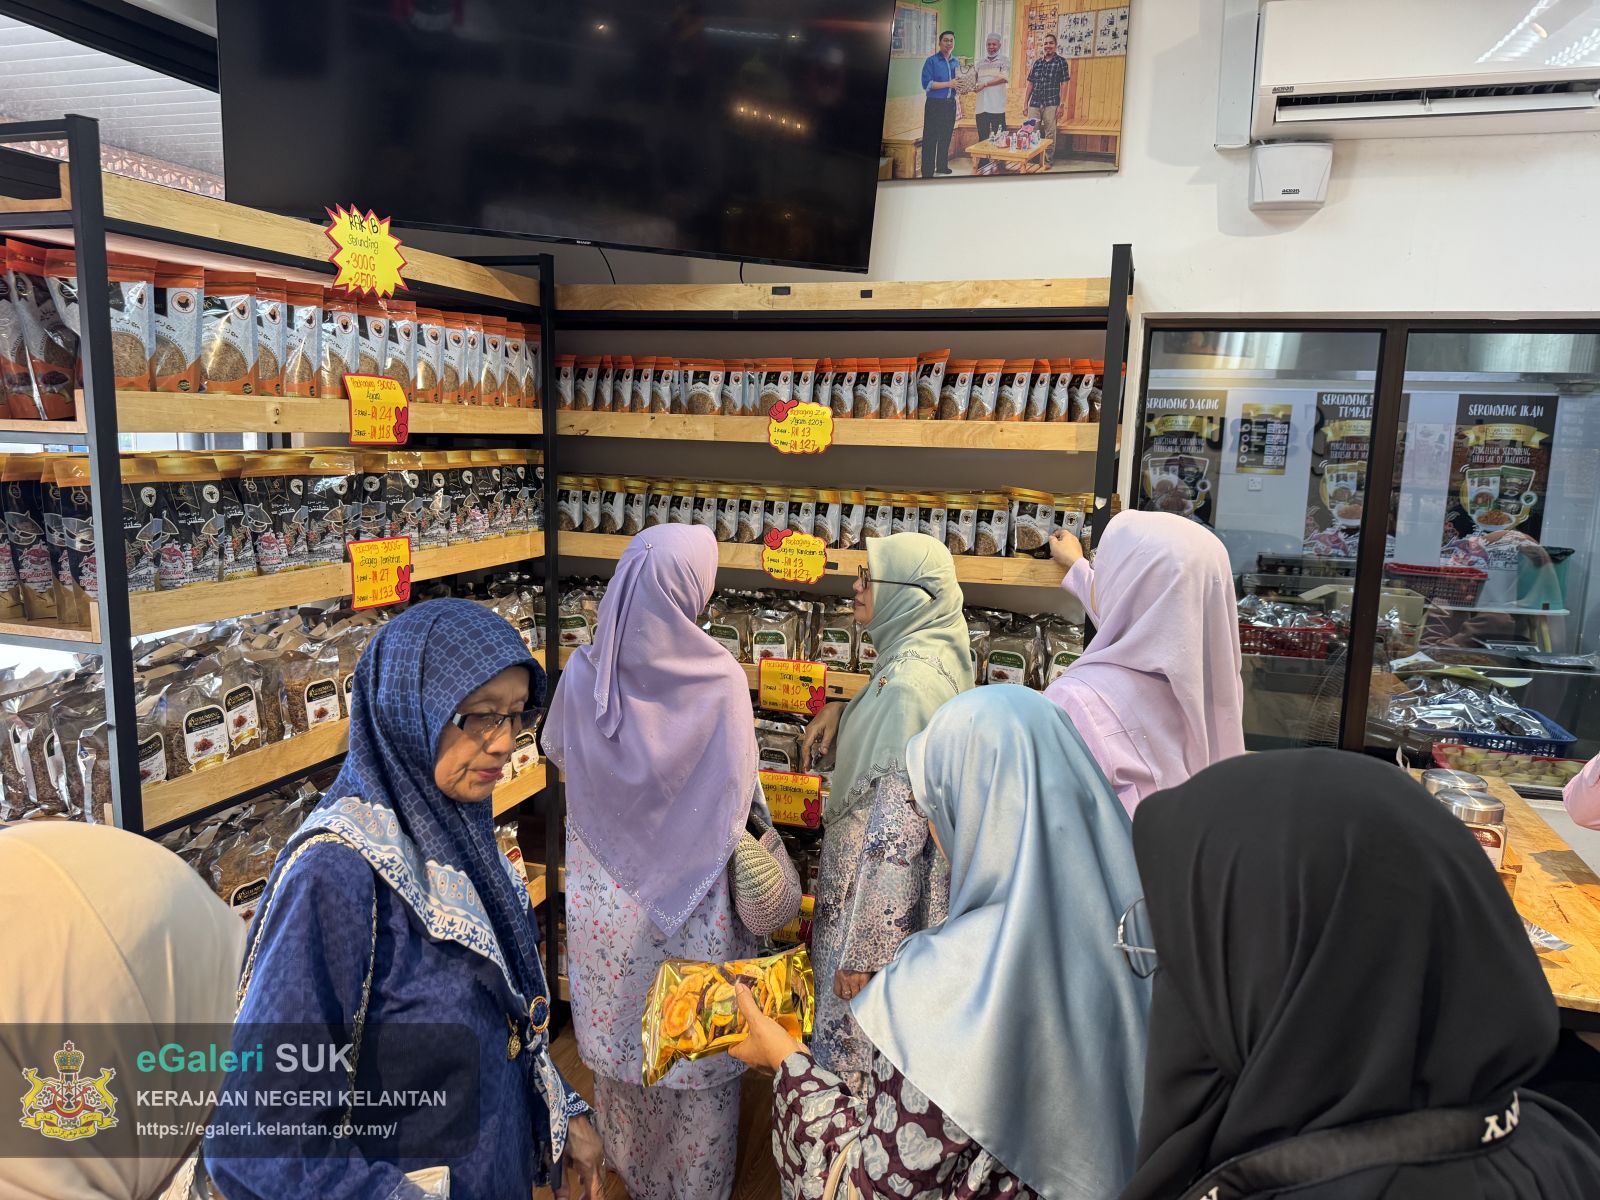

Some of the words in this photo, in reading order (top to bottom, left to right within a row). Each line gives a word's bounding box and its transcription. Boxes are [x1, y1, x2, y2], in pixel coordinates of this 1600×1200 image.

[1190, 398, 1220, 411] DAGING
[1520, 405, 1544, 418] IKAN
[801, 427, 811, 437] 13
[799, 439, 816, 450] 127
[380, 585, 393, 600] 133
[791, 699, 806, 709] 145
